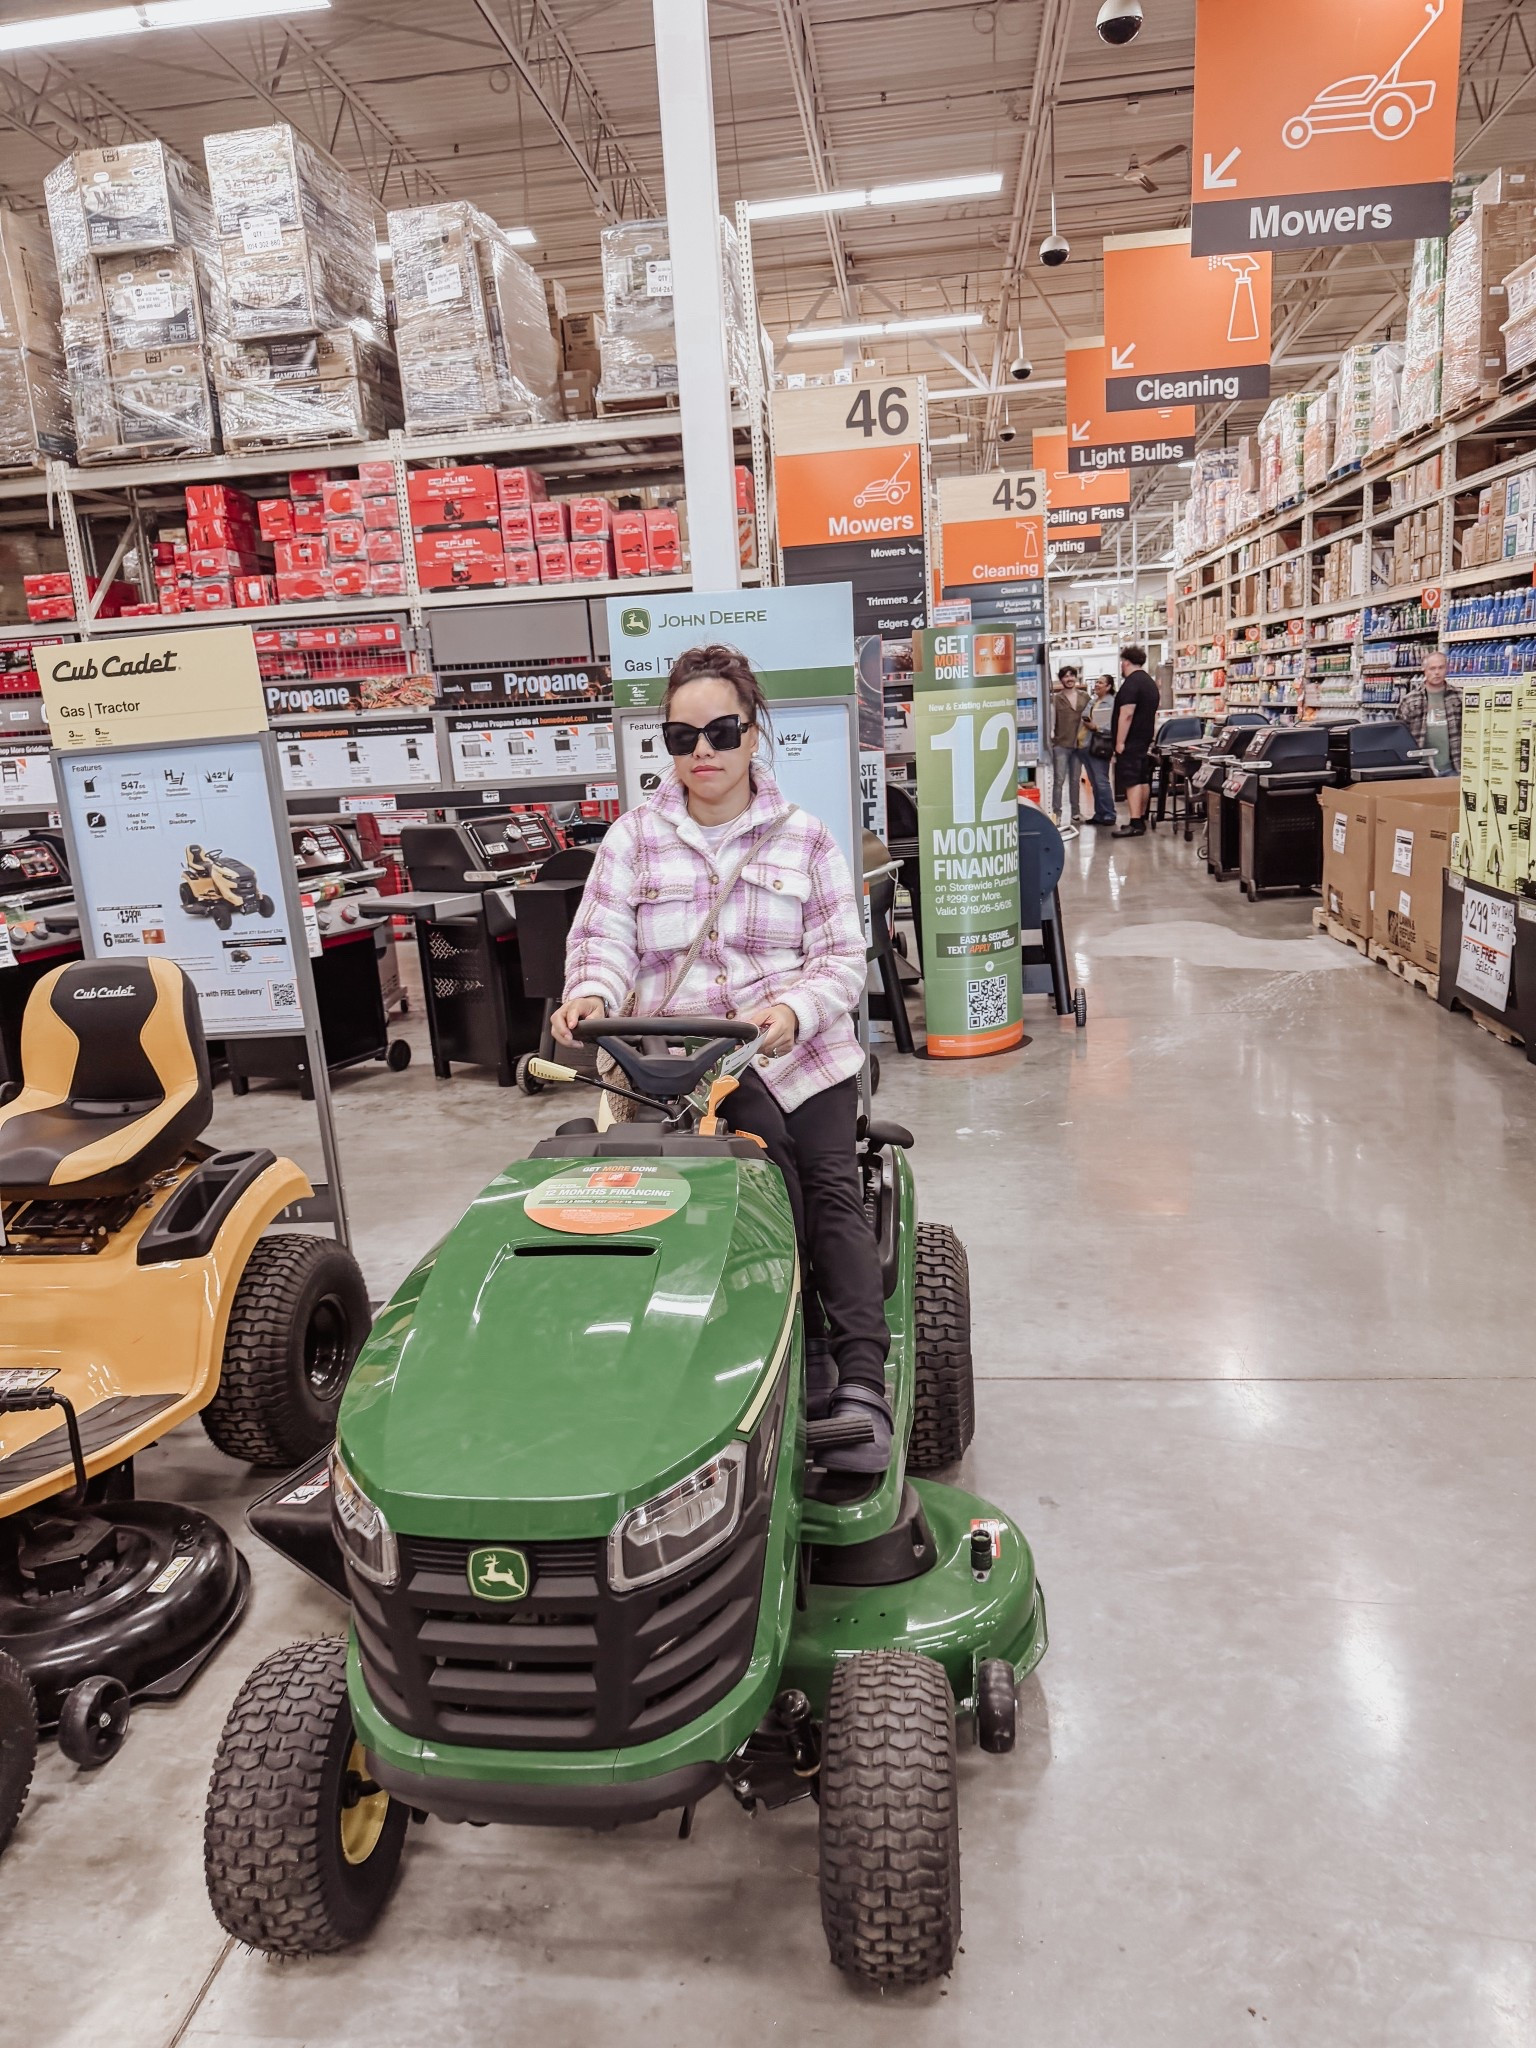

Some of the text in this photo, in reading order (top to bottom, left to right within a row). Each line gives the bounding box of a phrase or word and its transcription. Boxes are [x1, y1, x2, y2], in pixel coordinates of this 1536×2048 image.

[1249, 202, 1392, 240] Mowers
[274, 370, 306, 379] HAMPTON
[1136, 373, 1240, 404] Cleaning
[845, 386, 910, 438] 46
[1079, 442, 1184, 470] Light Bulbs
[992, 476, 1037, 511] 45
[1091, 506, 1125, 520] Fans
[828, 513, 915, 537] Mowers
[870, 547, 906, 559] Mowers
[1047, 541, 1085, 554] ghting
[972, 562, 1039, 580] Cleaning
[1000, 586, 1028, 594] Cleaners
[866, 594, 908, 607] Trimmers
[1003, 606, 1031, 614] Cleaners
[658, 609, 767, 628] JOHN DEERE
[877, 618, 909, 632] Edgers
[934, 634, 969, 655] GET
[52, 650, 178, 683] Cub Cadet
[624, 659, 653, 672] Gas
[934, 653, 969, 667] MORE
[935, 665, 970, 680] DONE
[503, 672, 589, 697] Propane
[266, 687, 350, 712] Propane
[928, 703, 945, 712] New
[945, 702, 952, 711] &
[953, 700, 981, 711] Existing
[60, 701, 140, 718] Gas Tractor
[455, 721, 472, 730] Shop
[472, 719, 489, 729] More
[489, 718, 515, 729] Propane
[515, 717, 532, 726] Grills
[532, 716, 540, 725] at
[539, 715, 588, 725] homedepot.com
[69, 730, 75, 738] 3
[277, 729, 349, 740] Grills at homedepot.com
[71, 764, 103, 773] Features
[930, 711, 1018, 824] 12
[932, 822, 1018, 856] MONTHS
[933, 849, 1018, 880] FINANCING
[935, 884, 947, 892] on
[949, 880, 992, 892] Storewide
[935, 894, 944, 904] of
[946, 894, 968, 904] $299
[982, 892, 1002, 902] More.
[935, 906, 957, 916] Valid
[1491, 902, 1502, 918] BUY
[103, 931, 113, 947] 6
[960, 935, 980, 945] EASY
[981, 934, 987, 943] &
[947, 941, 1001, 955] TEXT APPLY TO
[1463, 939, 1497, 966] GET ONE FREE
[1475, 958, 1493, 977] SELECT
[73, 984, 136, 1000] Cub Cadet
[220, 989, 236, 997] FREE
[558, 1188, 607, 1196] MONTHS
